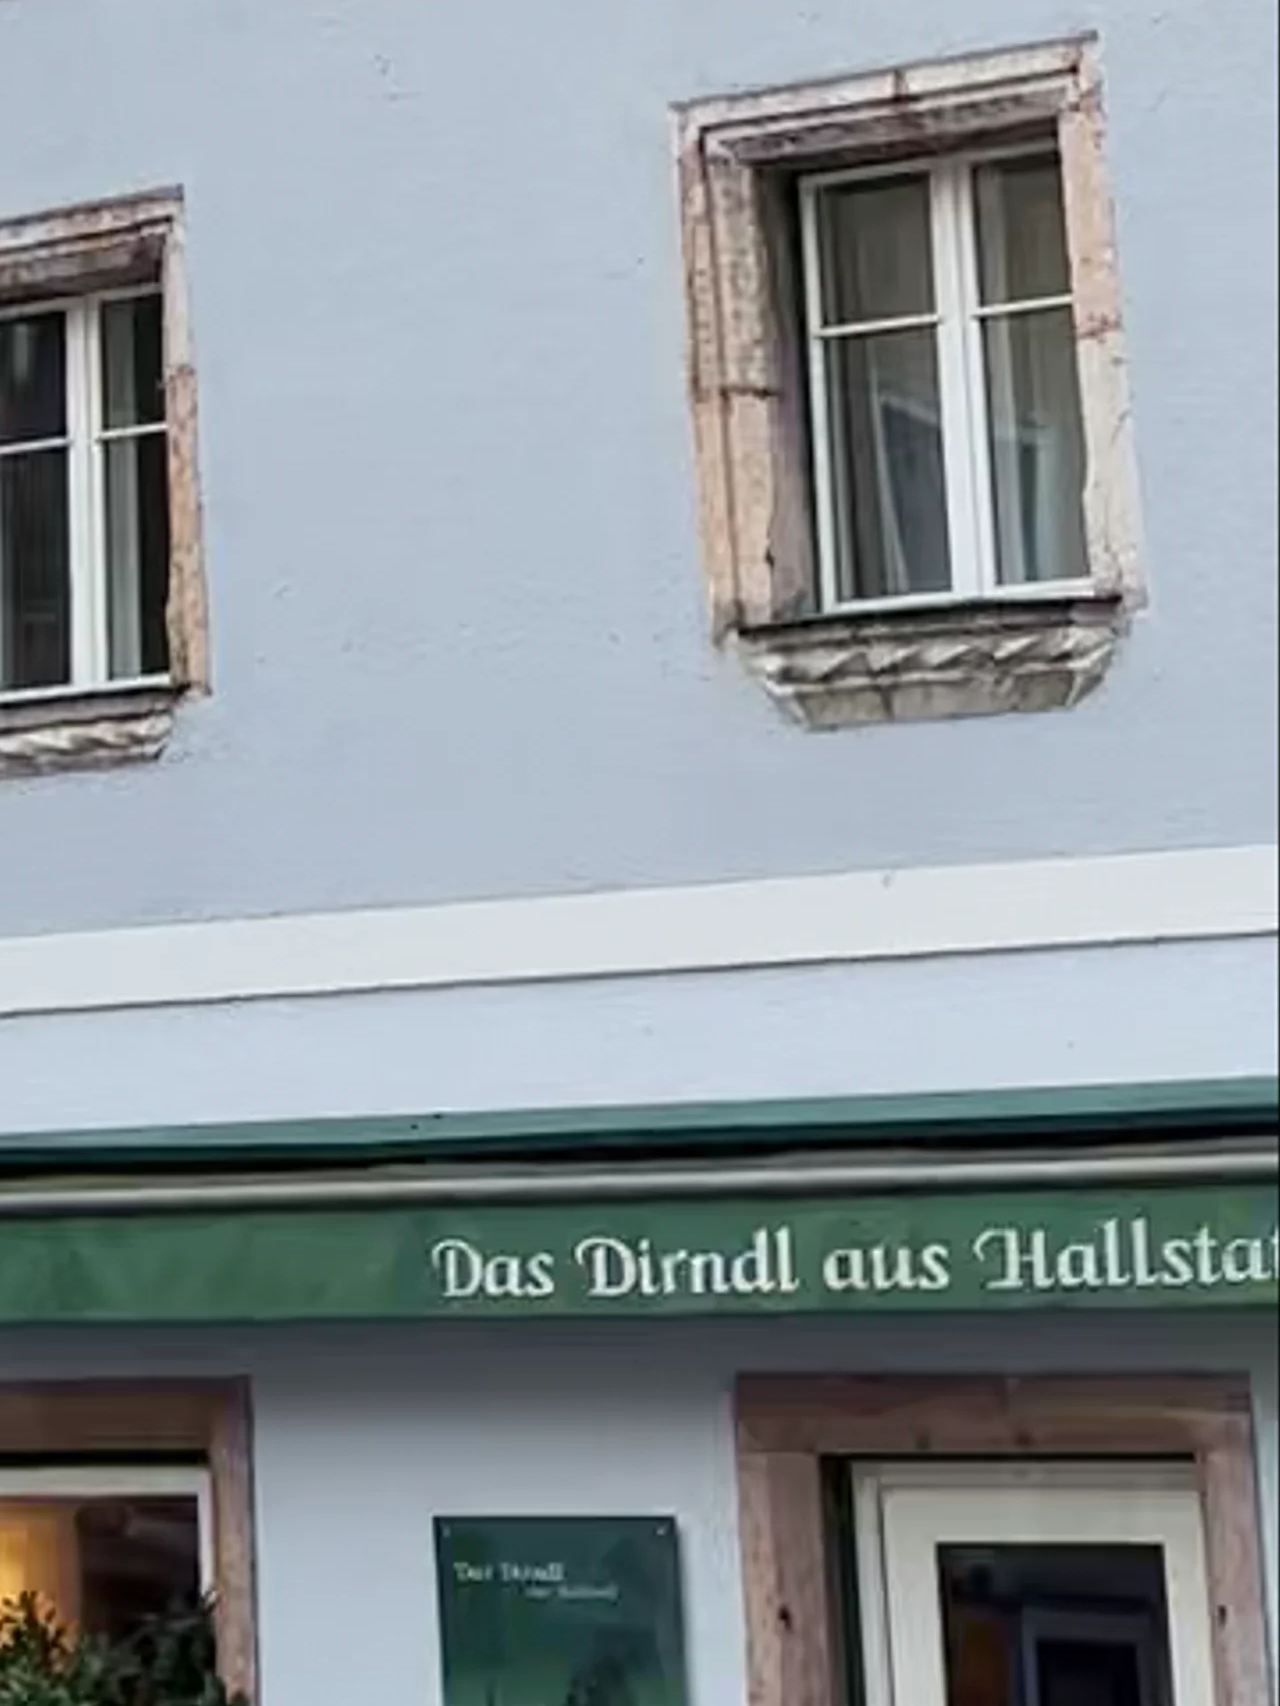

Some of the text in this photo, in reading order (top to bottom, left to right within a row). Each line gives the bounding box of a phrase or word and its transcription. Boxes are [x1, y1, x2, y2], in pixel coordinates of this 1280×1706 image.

[431, 1238, 556, 1297] Das
[575, 1223, 800, 1297] Dirndl
[822, 1242, 951, 1290] aus
